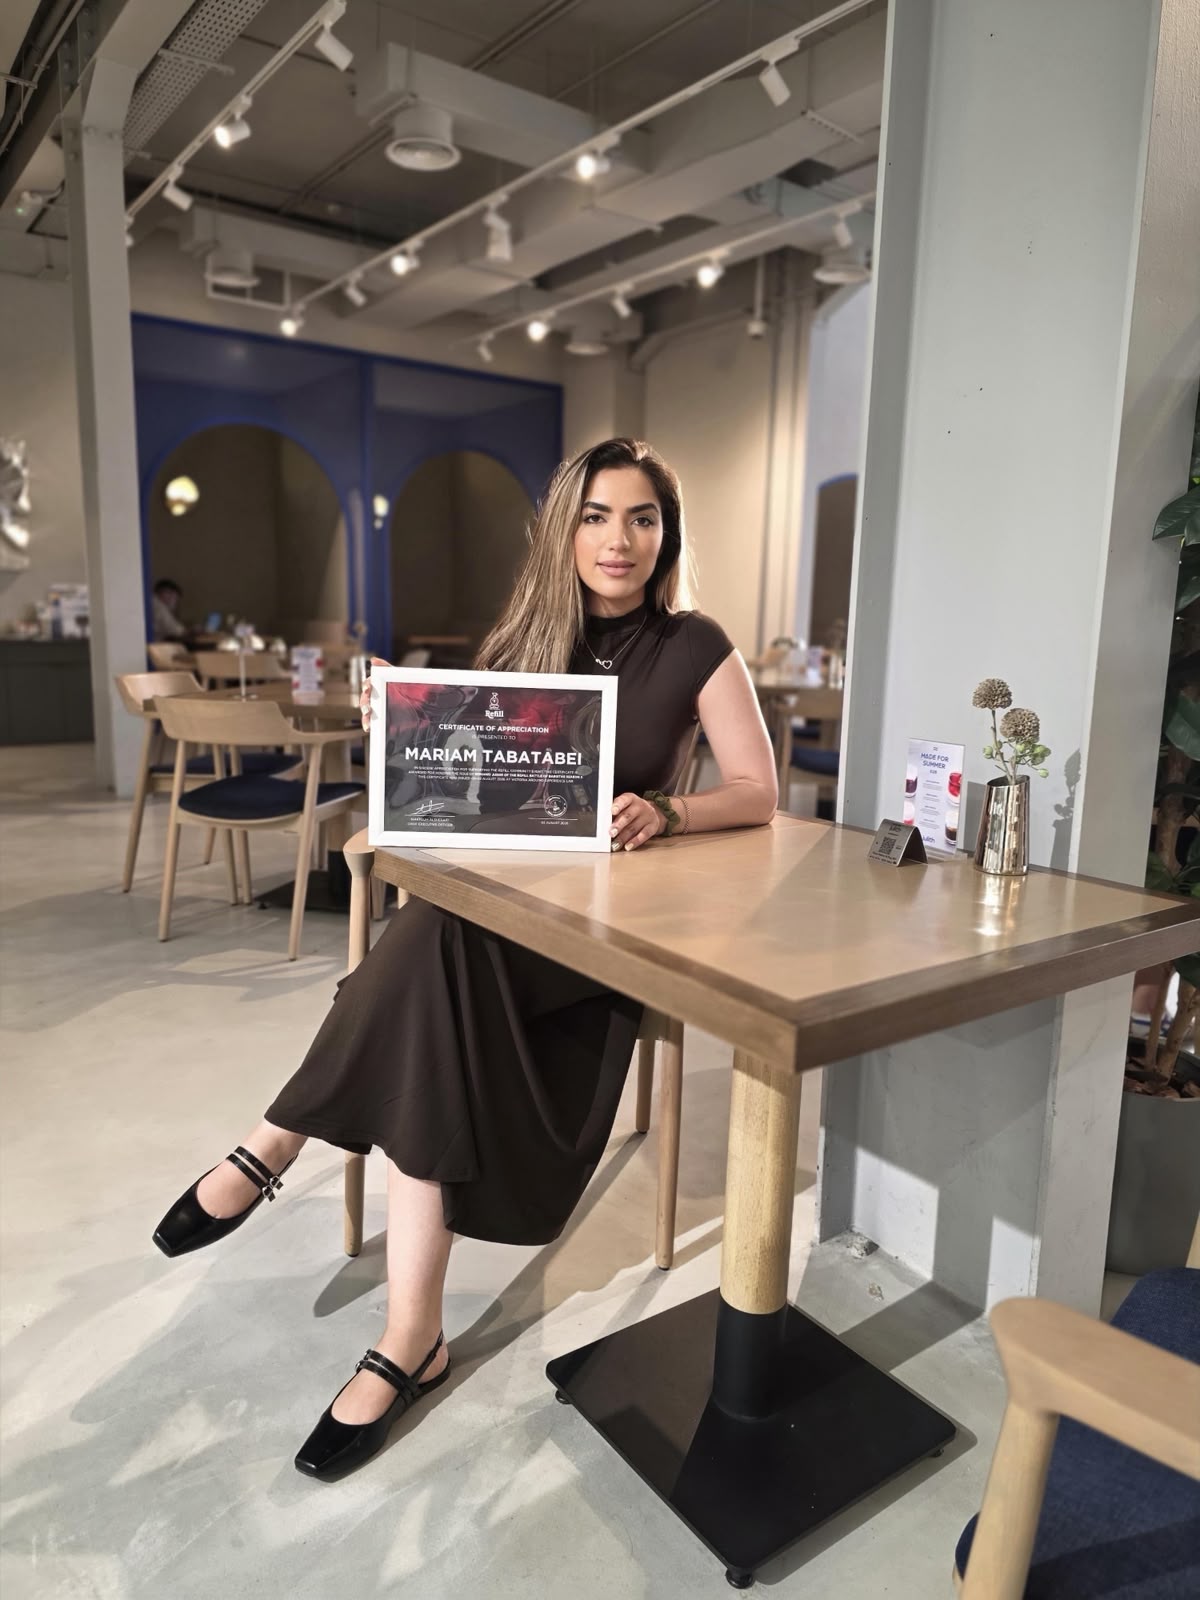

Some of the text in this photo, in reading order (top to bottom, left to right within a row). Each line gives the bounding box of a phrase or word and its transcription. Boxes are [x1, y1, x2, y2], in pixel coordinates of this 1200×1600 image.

[485, 709, 504, 719] Refill
[438, 723, 485, 732] CERTIFICATE
[497, 726, 550, 734] APPRECIATION
[405, 747, 477, 762] MARIAM
[922, 761, 946, 769] SUMMER
